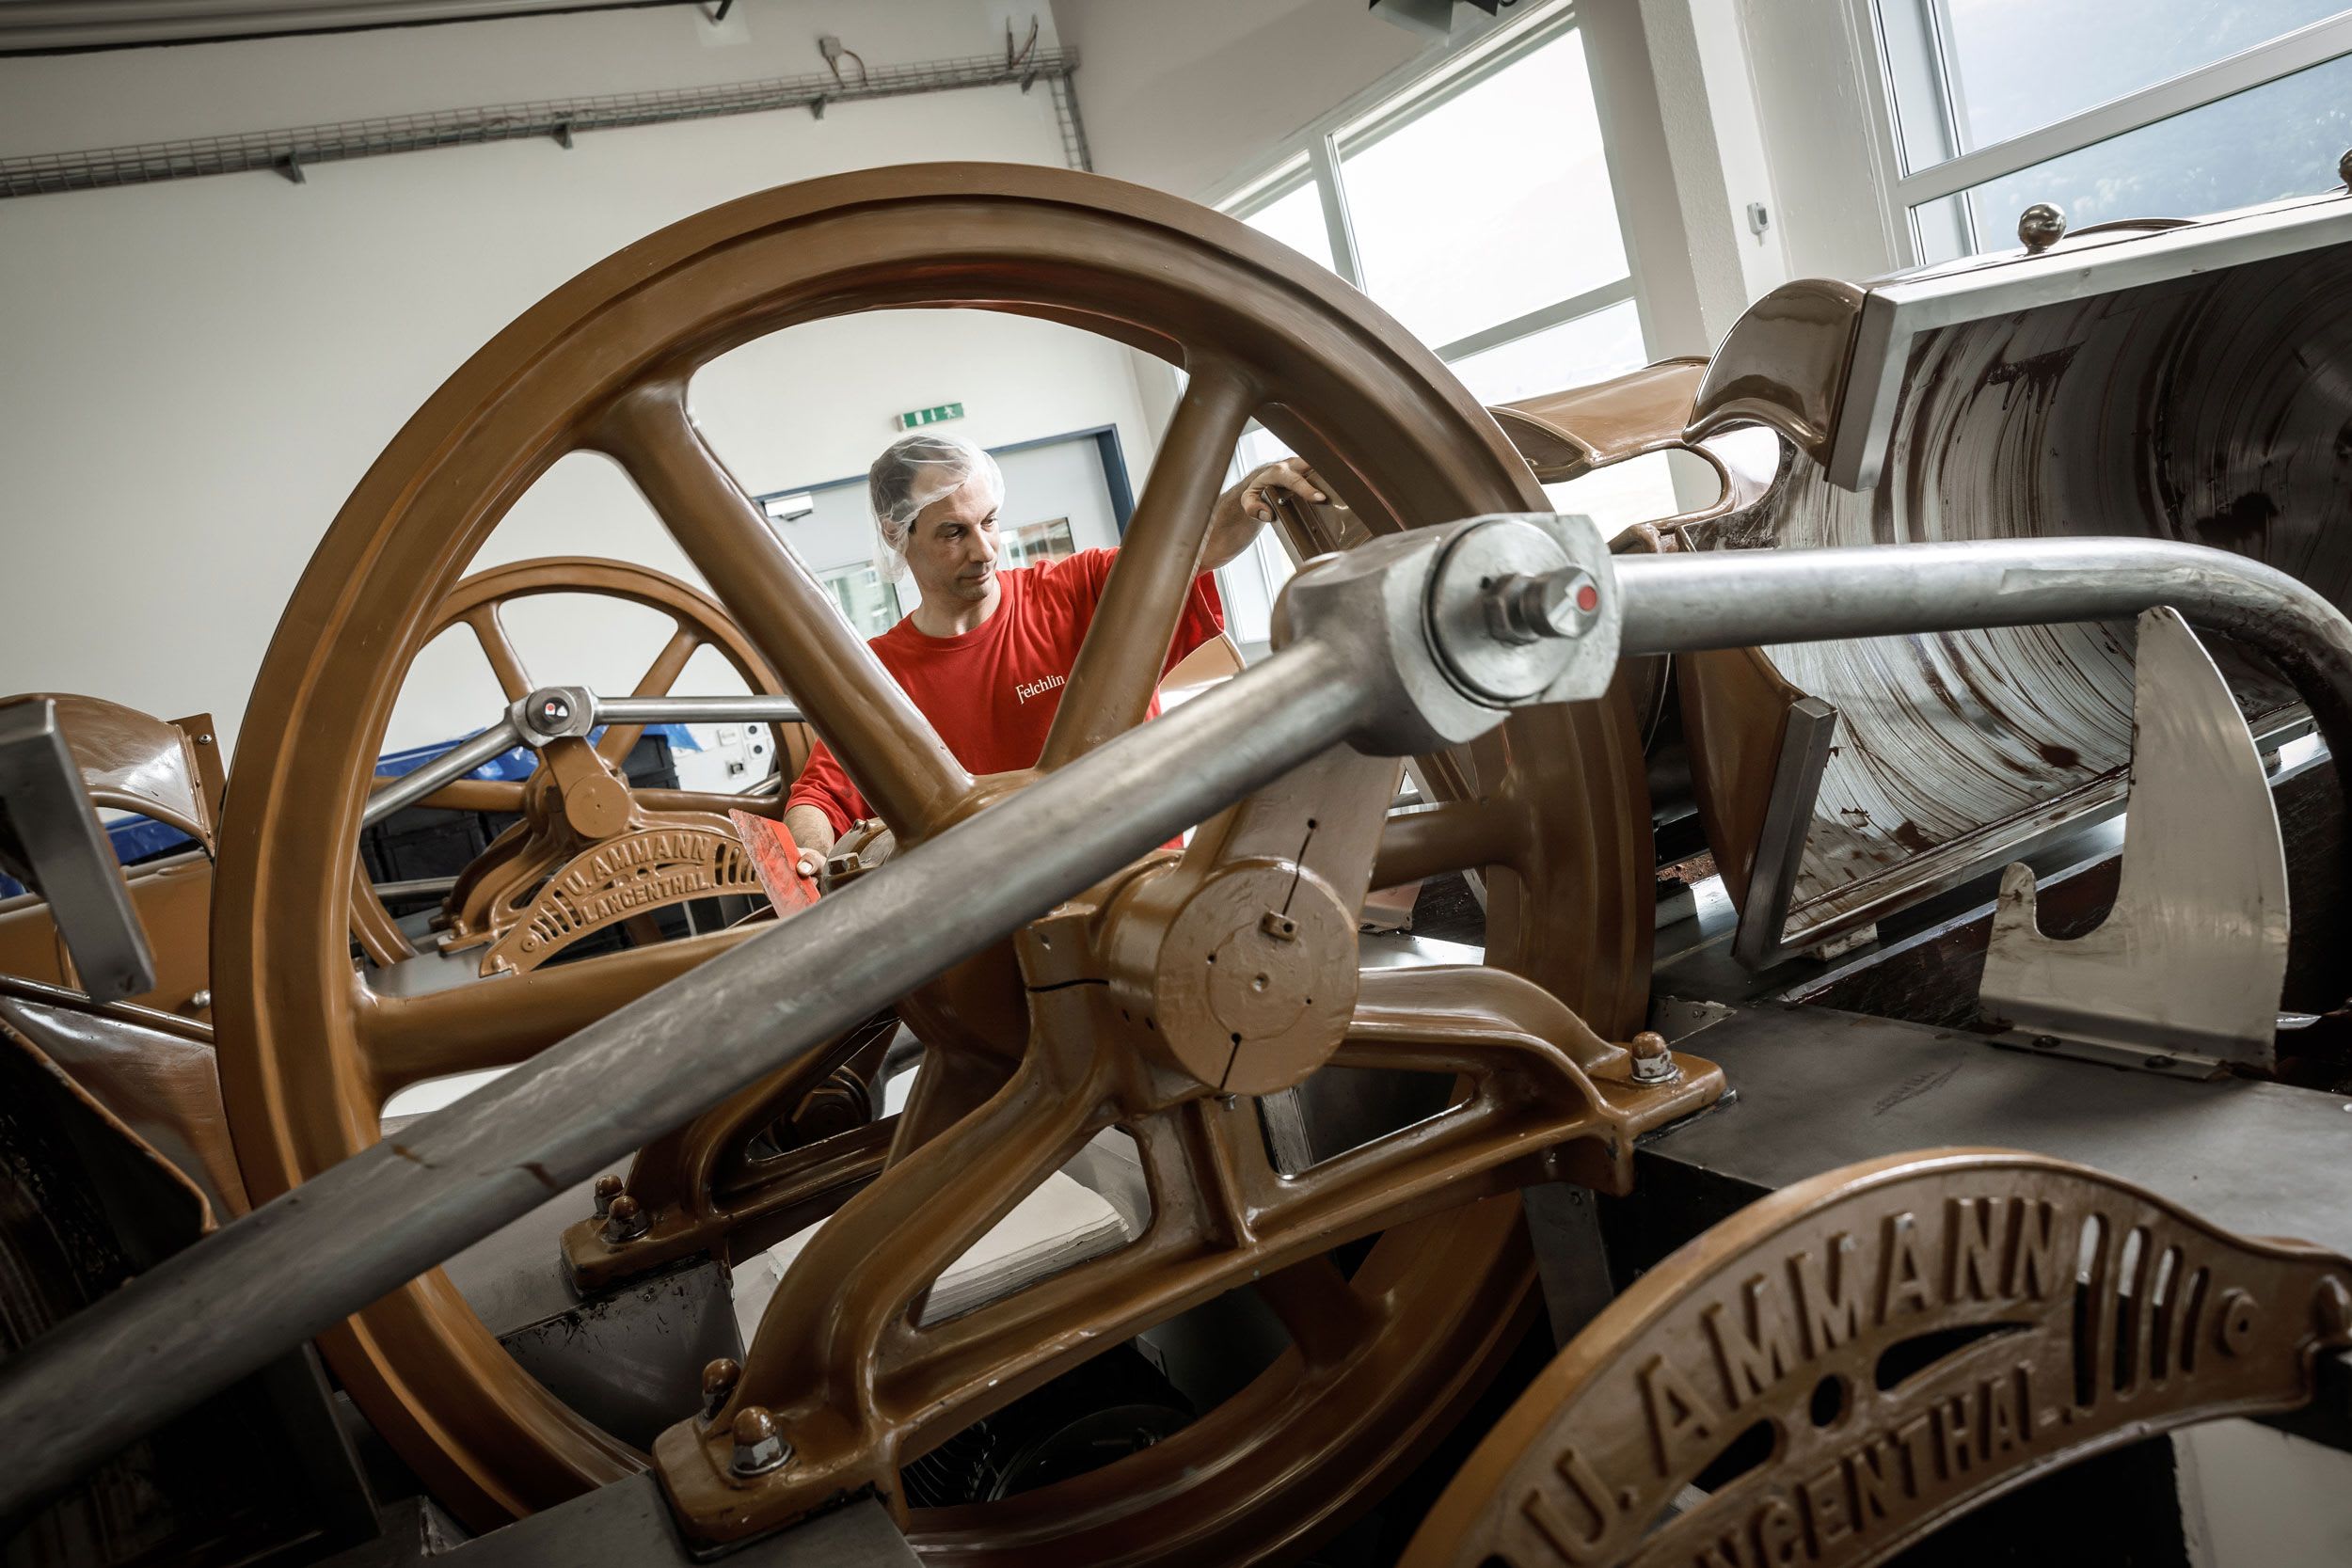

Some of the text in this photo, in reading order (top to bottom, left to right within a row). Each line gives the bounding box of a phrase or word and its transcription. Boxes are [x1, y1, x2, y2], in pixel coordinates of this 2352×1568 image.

[1015, 674, 1066, 705] Felchlin
[564, 833, 711, 896] U. AMMANN
[1634, 1196, 2063, 1480] AMMANN
